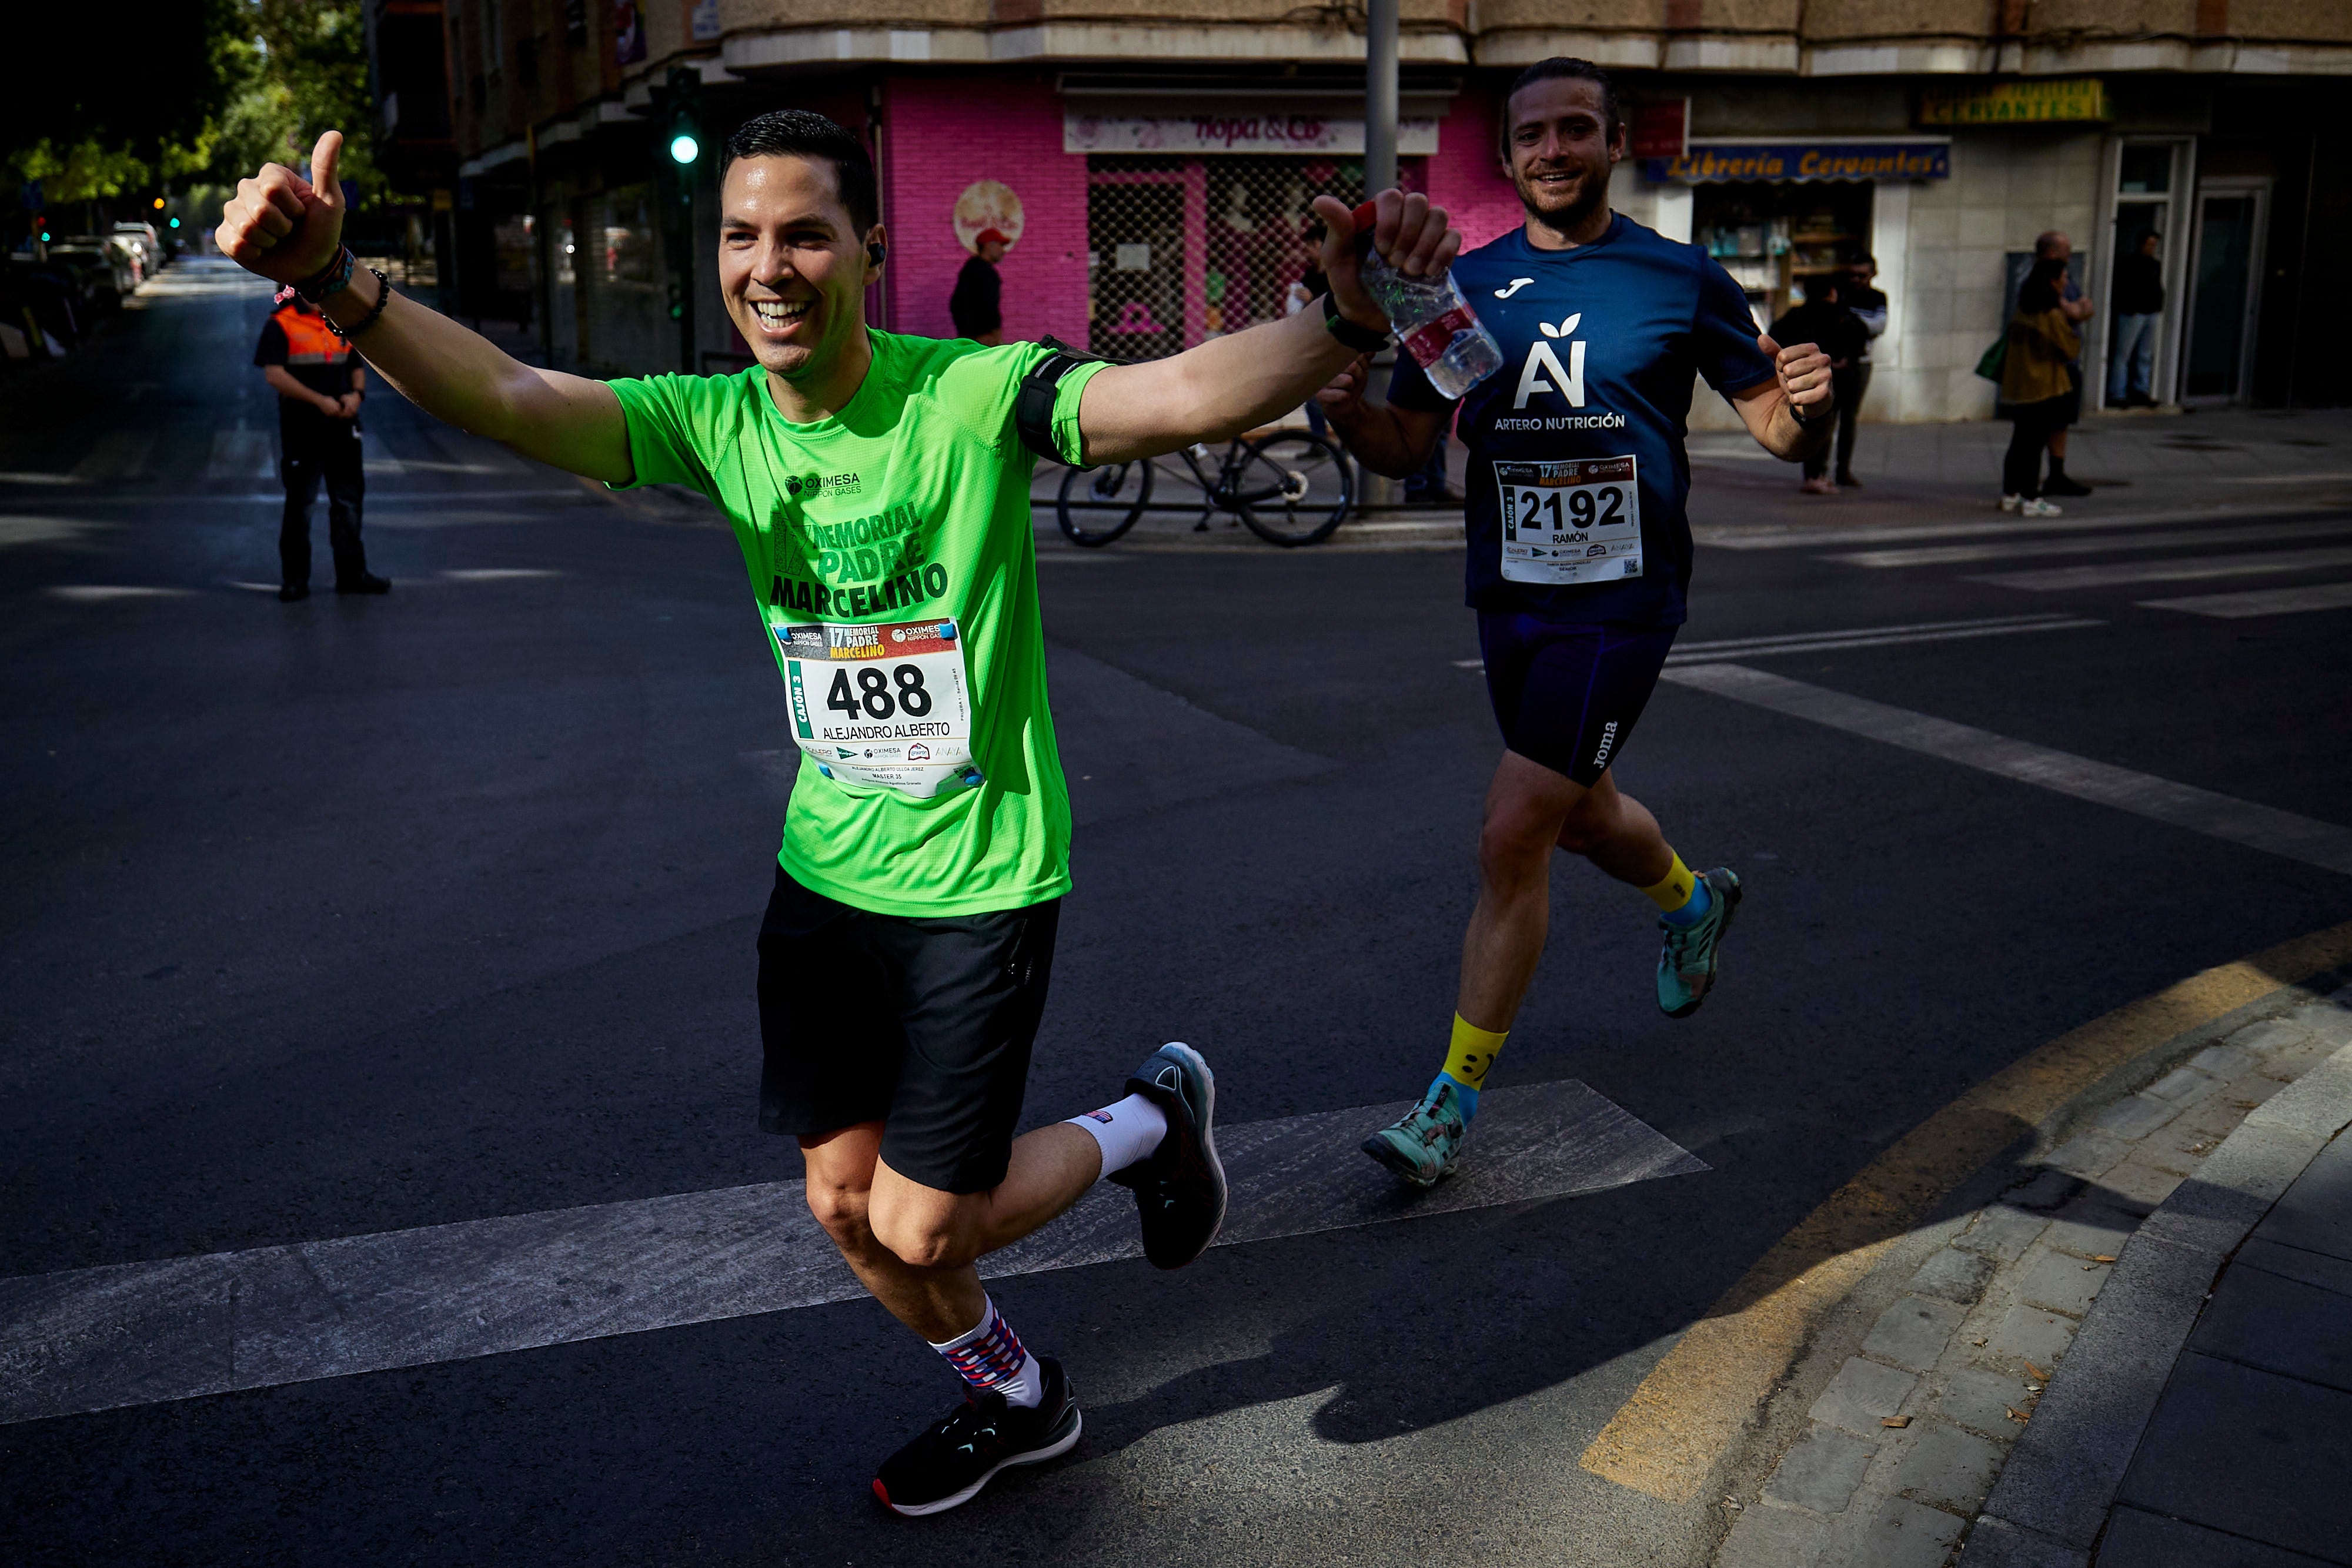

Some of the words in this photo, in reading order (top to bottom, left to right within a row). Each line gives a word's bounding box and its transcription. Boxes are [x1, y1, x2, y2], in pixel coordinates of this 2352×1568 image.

[1798, 150, 1933, 175] Cervantes
[1495, 418, 1542, 430] ARTERO
[1546, 412, 1625, 430] NUTRICIÓN
[1539, 464, 1553, 478] 17
[1553, 468, 1578, 478] PADRE
[1599, 462, 1630, 470] OXIMESA
[805, 473, 860, 489] OXIMESA
[1539, 475, 1581, 486] MARCELINO
[803, 486, 833, 497] NIPPON
[835, 486, 861, 496] GASES
[1521, 486, 1625, 530] 2192
[811, 501, 923, 550] MEMORIAL
[1552, 531, 1588, 544] RAMÓN
[817, 531, 925, 584] PADRE
[769, 563, 948, 618] MARCELINO
[791, 632, 822, 641] OXIMESA
[844, 626, 879, 637] MEMORIAL
[906, 624, 940, 635] OXIMES
[829, 628, 845, 647] 17
[846, 635, 878, 647] PADRE
[830, 644, 885, 658] MARCELINO
[793, 675, 801, 684] 3
[827, 664, 932, 720] 488
[793, 689, 808, 724] CAJÓN
[823, 726, 892, 740] ALEJANDRO
[894, 722, 950, 738] ALBERTO
[936, 747, 963, 756] ANAYA
